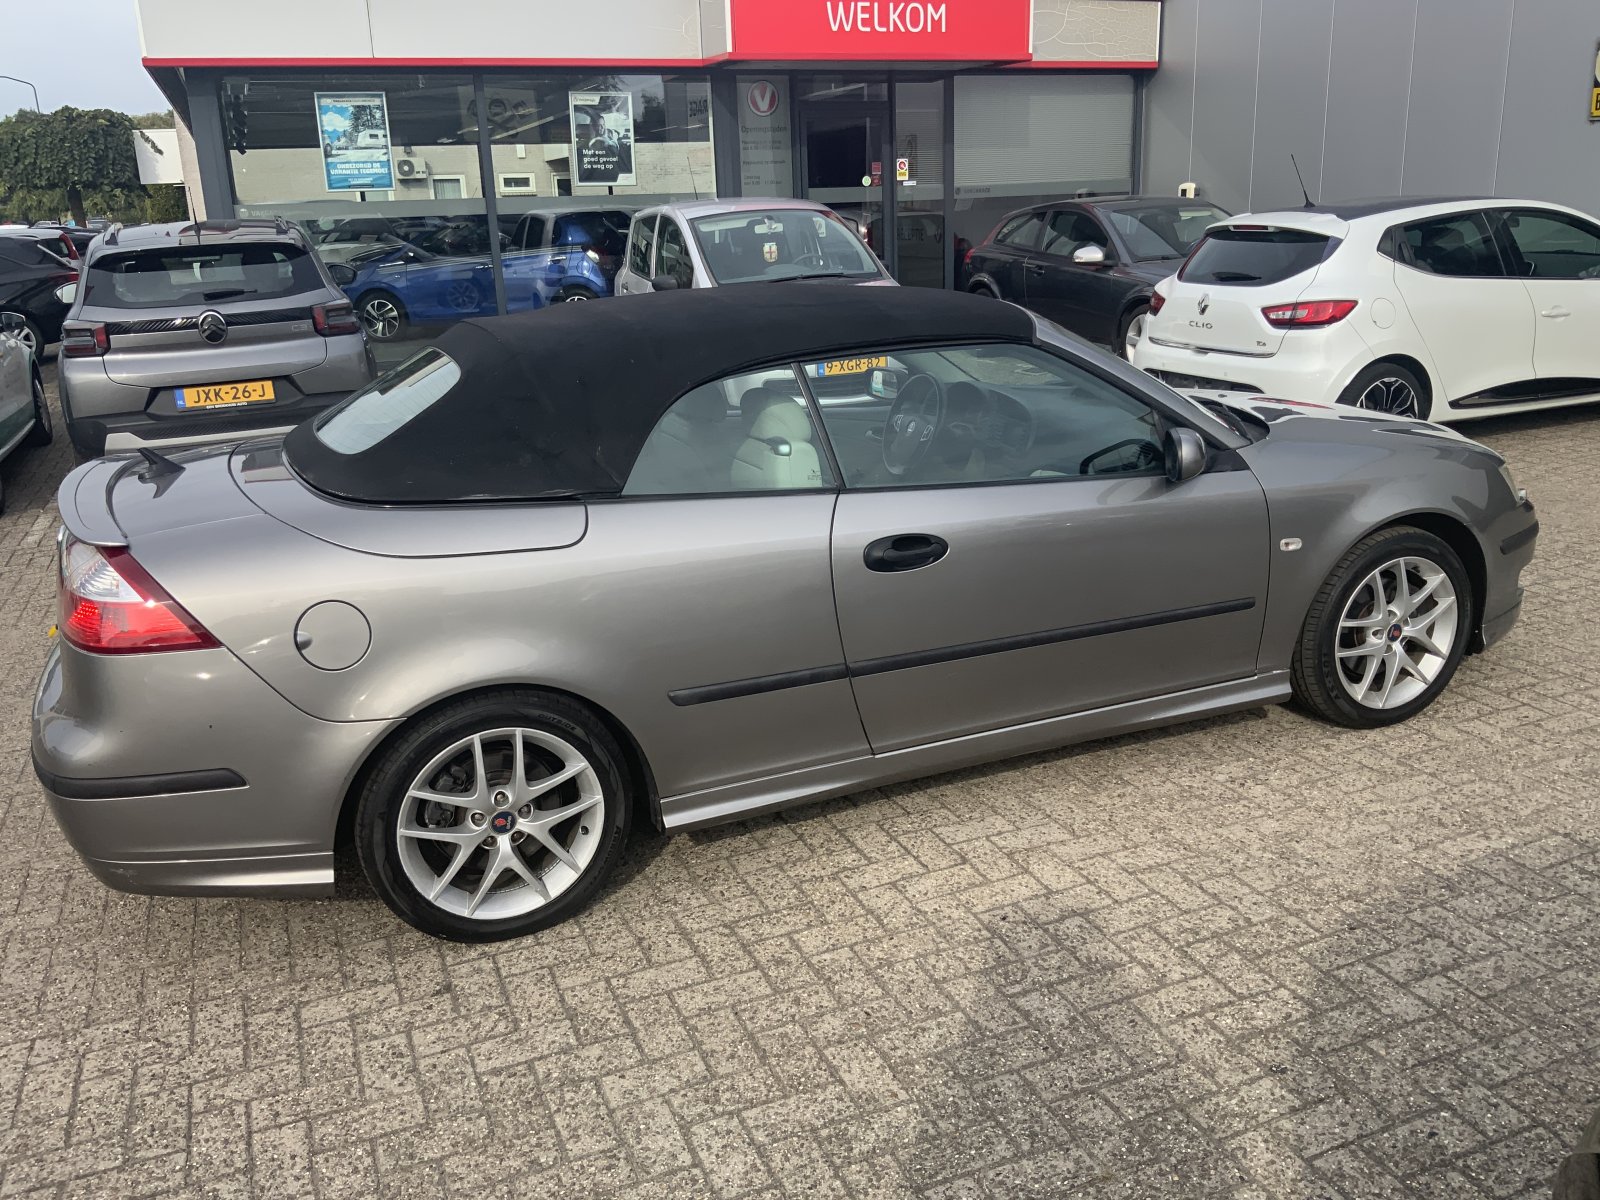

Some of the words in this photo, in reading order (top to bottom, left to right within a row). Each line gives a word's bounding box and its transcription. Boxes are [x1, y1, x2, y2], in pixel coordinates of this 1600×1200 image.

[826, 1, 946, 32] WELKOM
[1188, 320, 1213, 329] CLIO
[193, 383, 266, 404] JXK-26-J
